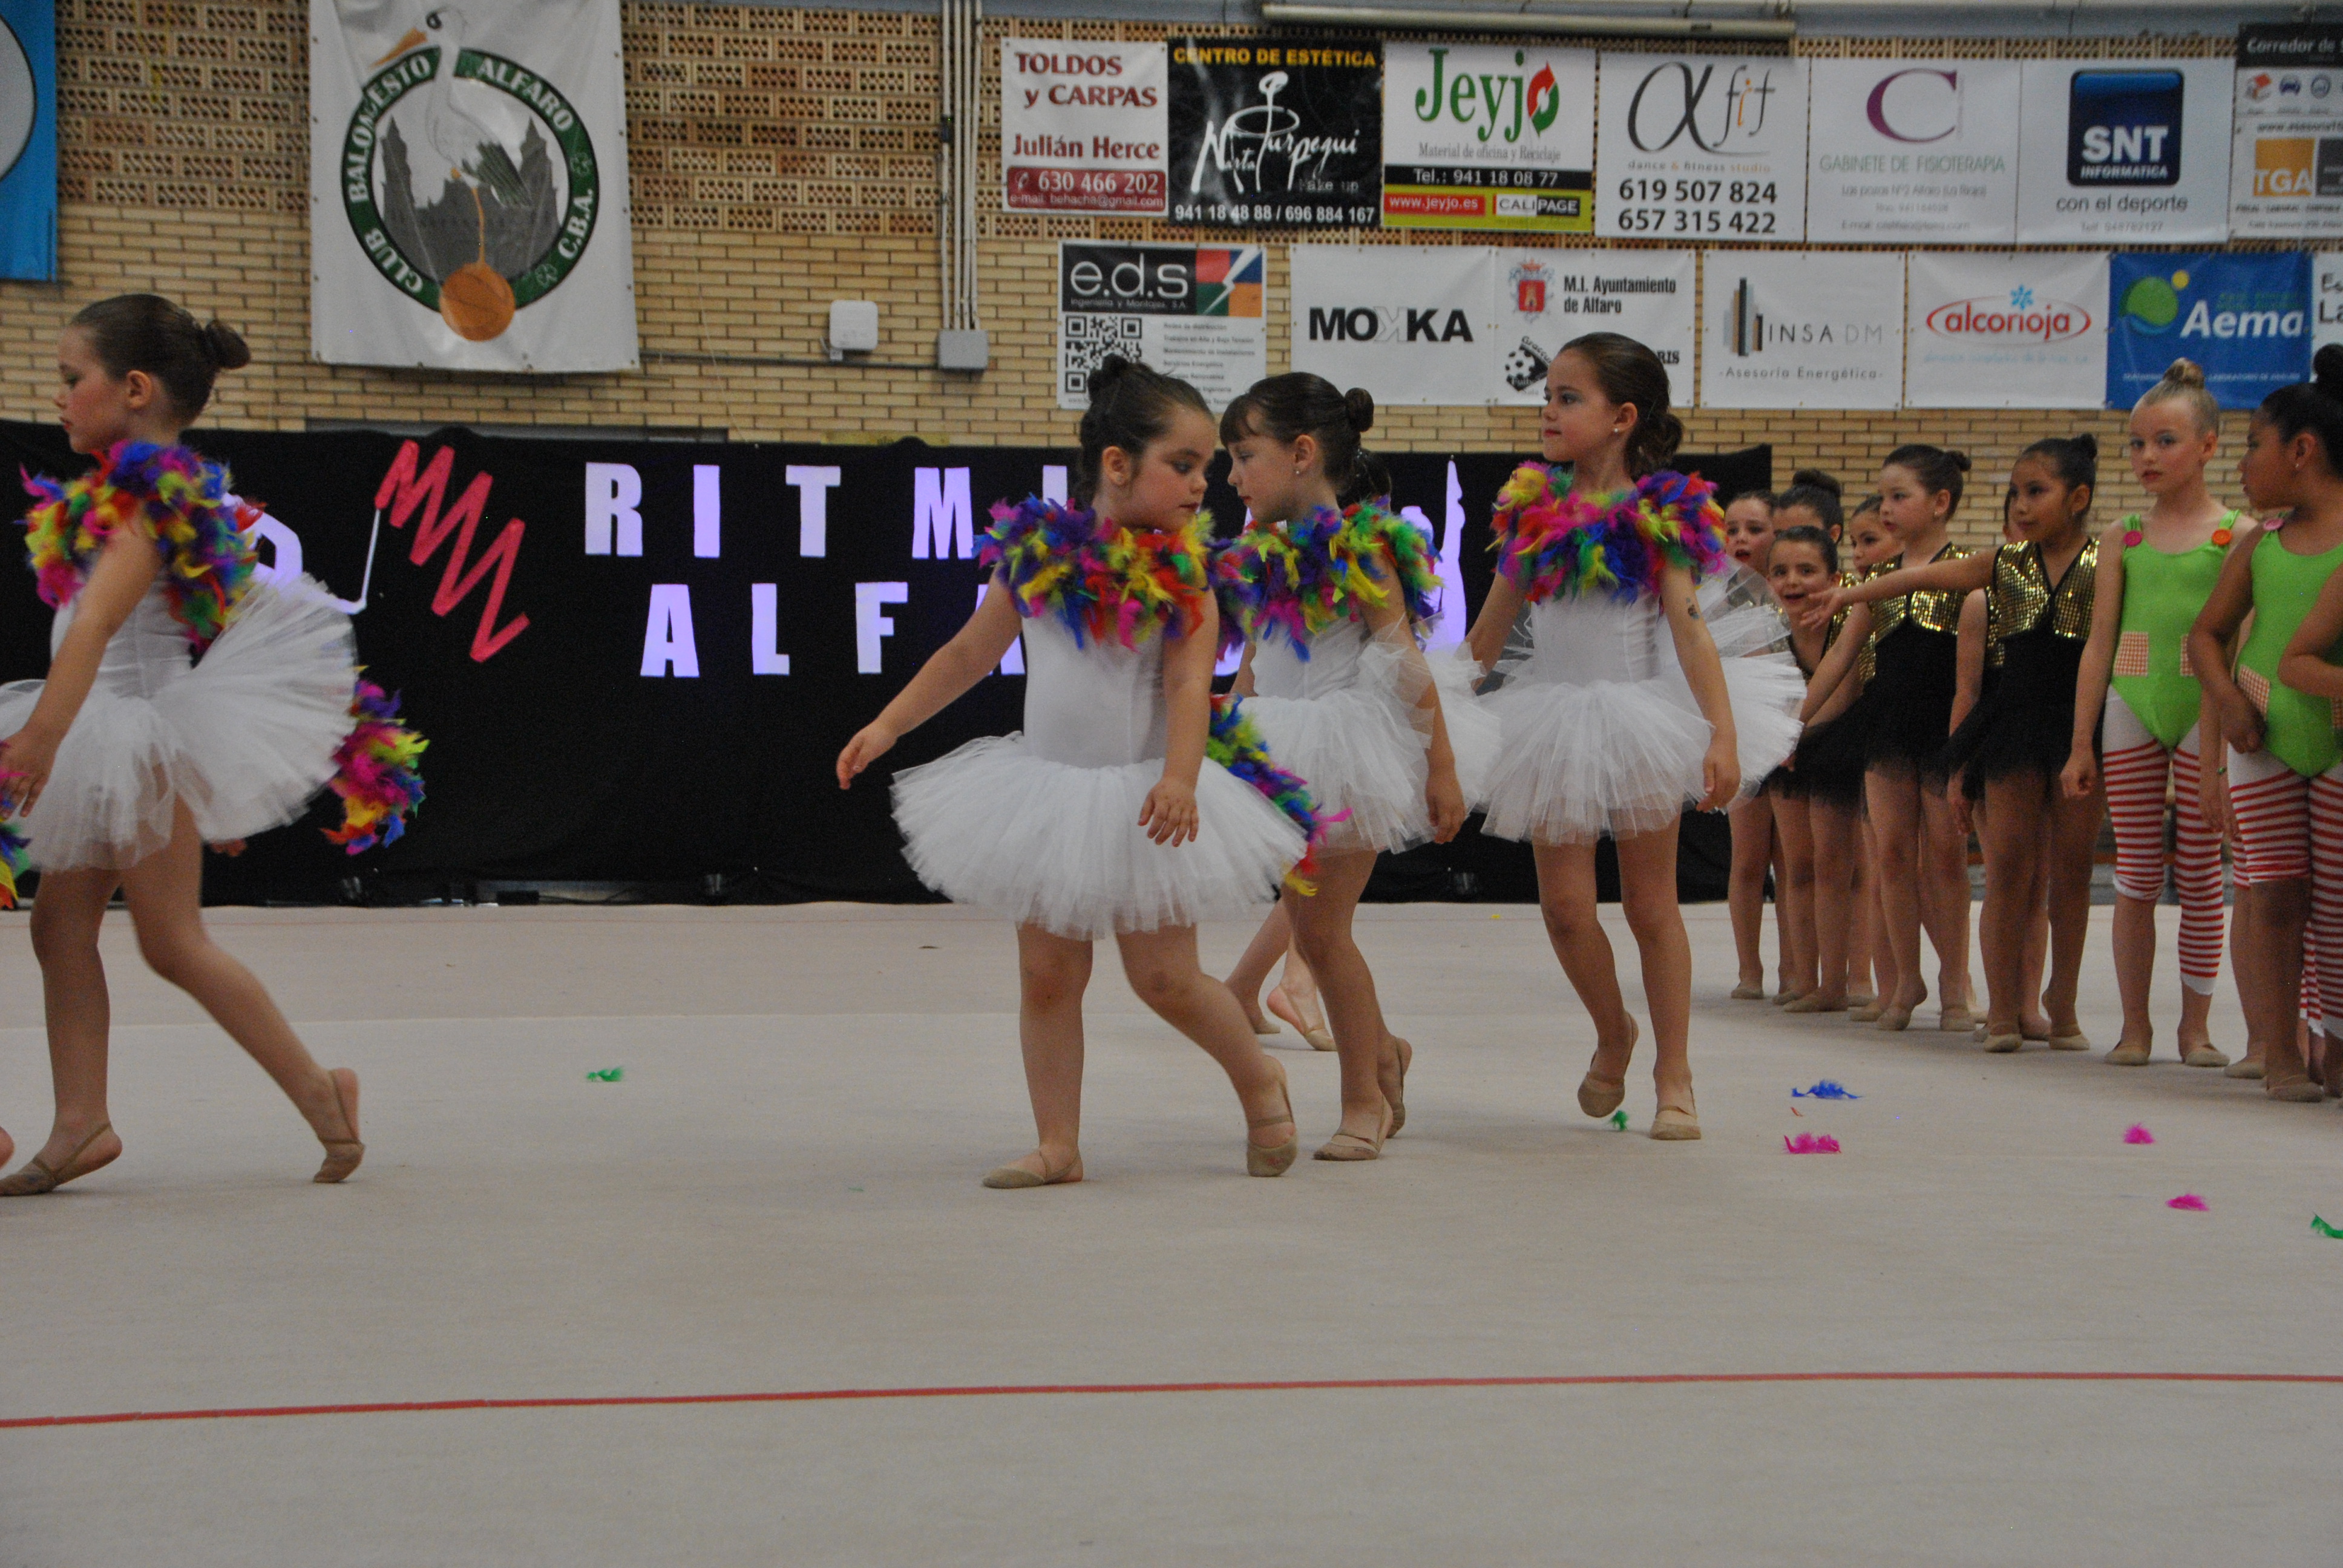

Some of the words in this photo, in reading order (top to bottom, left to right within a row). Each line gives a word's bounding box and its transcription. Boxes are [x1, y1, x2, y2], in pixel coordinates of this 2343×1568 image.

[1174, 47, 1252, 65] CENTRO
[1256, 48, 1281, 65] DE
[2247, 37, 2315, 53] Corredor
[2319, 37, 2336, 53] de
[1014, 51, 1122, 76] TOLDOS
[479, 55, 574, 132] ALFARO
[1024, 87, 1040, 108] y
[1049, 85, 1158, 108] CARPAS
[1012, 134, 1084, 158] Julián
[1092, 135, 1161, 160] Herce
[1419, 142, 1461, 158] Material
[1463, 145, 1475, 158] de
[1476, 145, 1509, 159] oficina
[1519, 146, 1562, 164] Reciclaje
[2081, 125, 2169, 163] SNT
[1819, 154, 1886, 173] GABINETE
[1890, 155, 1908, 173] DE
[1916, 154, 2006, 174] FISIOTERAPIA
[2080, 165, 2168, 180] INFORMATICA
[1038, 171, 1075, 192] 630
[1080, 172, 1117, 193] 466
[1124, 173, 1159, 194] 202
[1415, 168, 1447, 183] Tel.:
[1452, 169, 1482, 185] 941
[1489, 170, 1508, 186] 18
[1513, 171, 1534, 186] 08
[1539, 172, 1559, 188] 77
[2253, 168, 2313, 194] TGA
[1619, 178, 1667, 201] 619
[1675, 179, 1722, 202] 507
[1729, 181, 1777, 204] 824
[1175, 204, 1202, 221] 941
[1208, 204, 1227, 221] 18
[1231, 204, 1249, 221] 48
[1254, 204, 1272, 221] 88
[1285, 205, 1312, 222] 696
[1316, 206, 1343, 223] 884
[1348, 206, 1375, 223] 167
[1389, 194, 1479, 213] www.jeyjo.es
[2056, 197, 2089, 212] con
[2095, 194, 2112, 212] el
[2118, 193, 2189, 215] deporte
[1617, 207, 1666, 231] 657
[1674, 209, 1721, 232] 315
[1728, 212, 1776, 234] 422
[364, 227, 424, 293] CLUB
[1070, 252, 1188, 299] e.d.s
[1563, 275, 1589, 293] M.I.
[1593, 275, 1677, 296] Ayuntamiento
[1563, 296, 1581, 313] de
[1582, 296, 1622, 315] Alfaro
[1945, 302, 2071, 341] alcorioja
[2180, 300, 2305, 339] Aema
[1769, 323, 1833, 343] INSA
[1846, 324, 1883, 344] DM
[1521, 335, 1553, 364] Graccu
